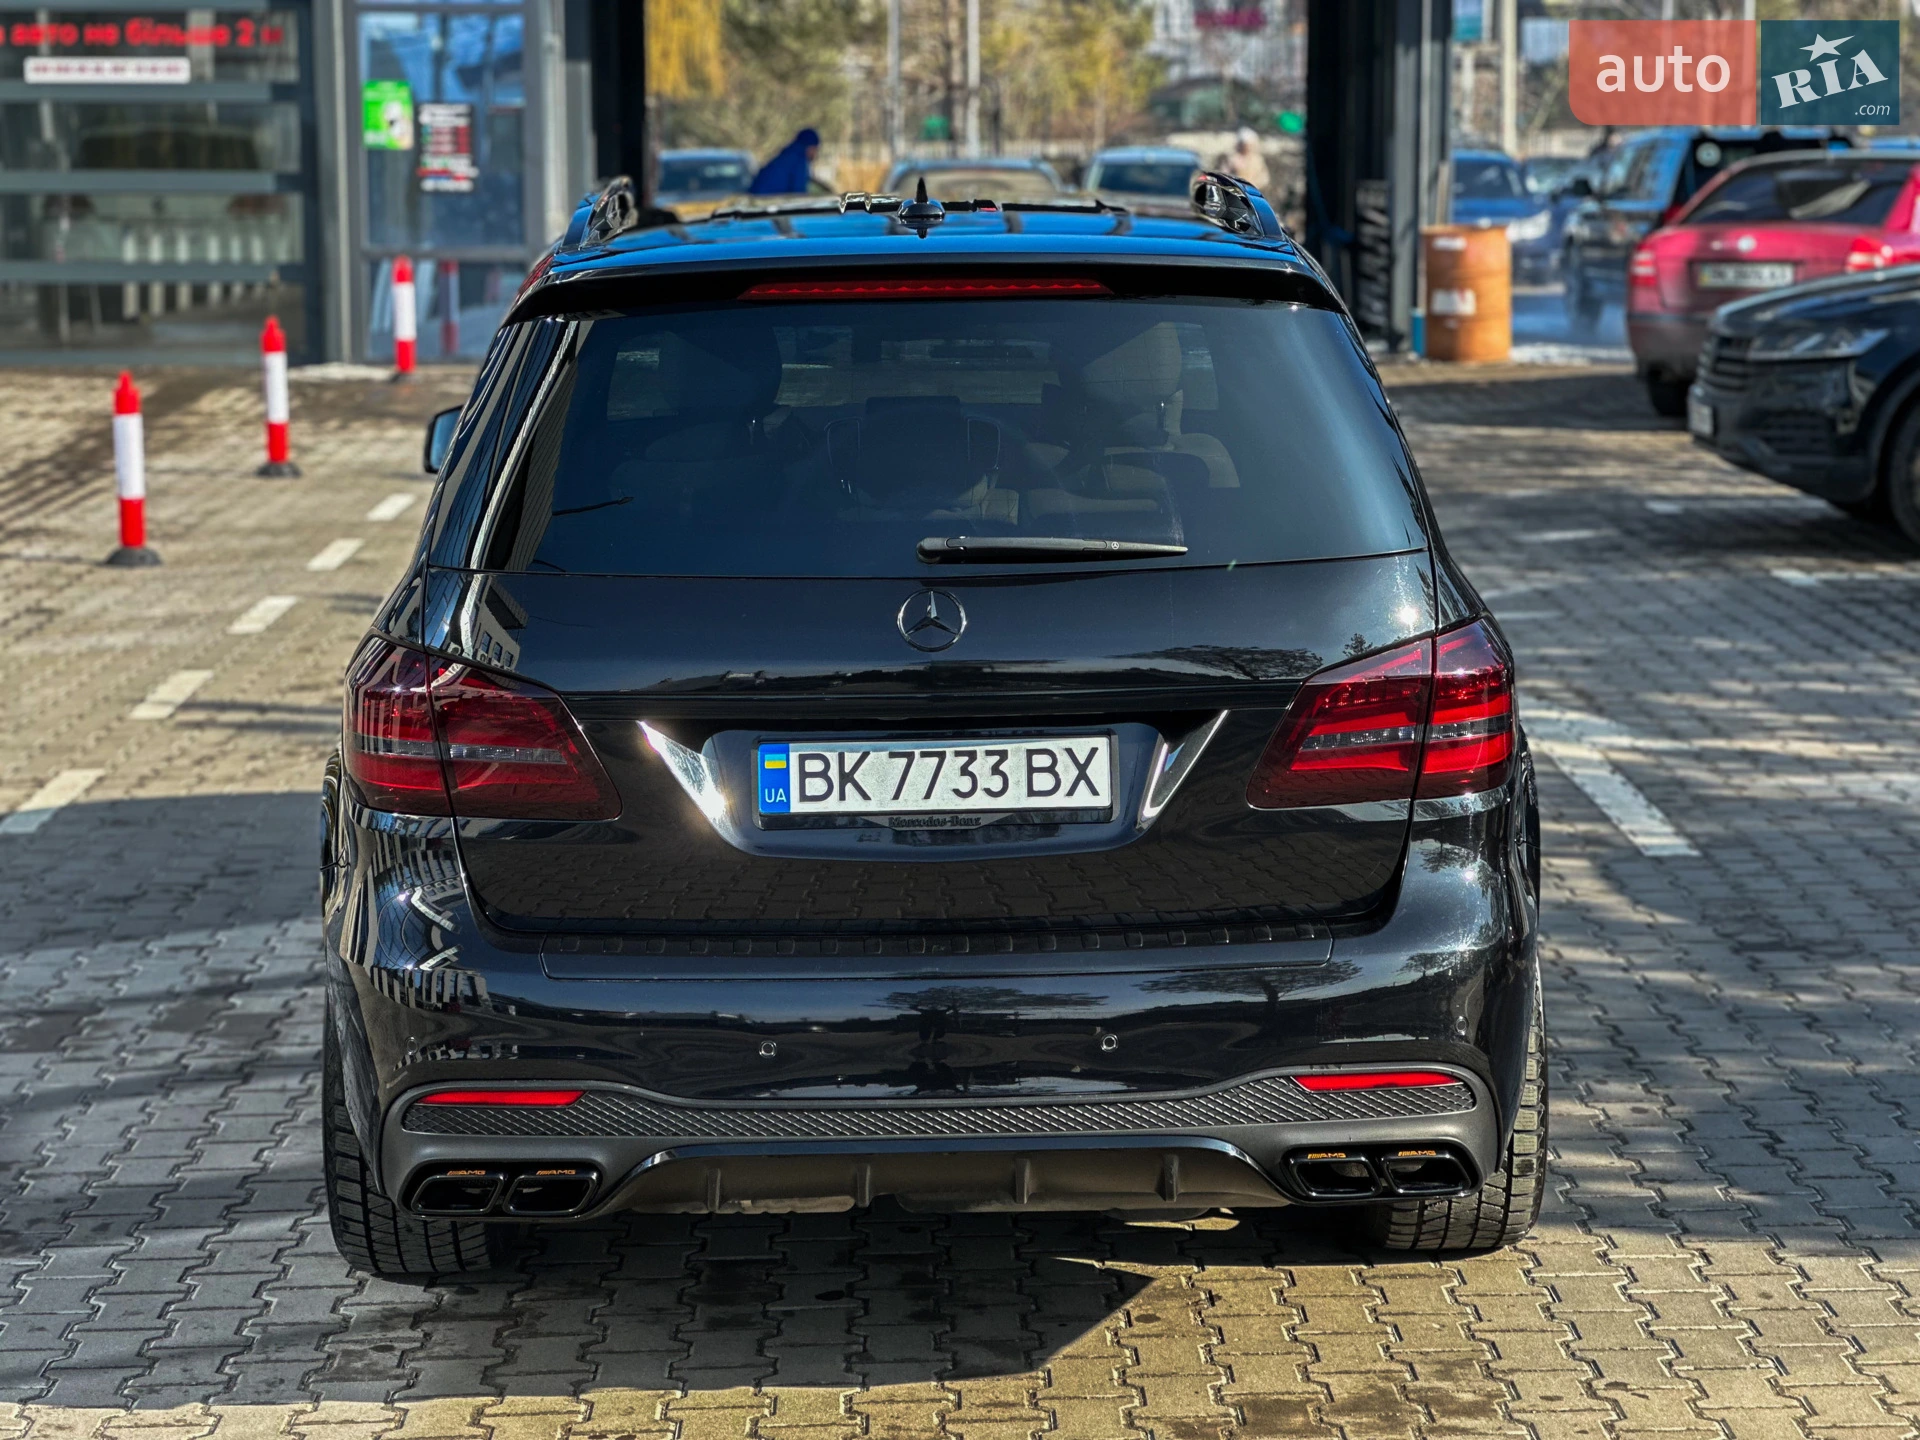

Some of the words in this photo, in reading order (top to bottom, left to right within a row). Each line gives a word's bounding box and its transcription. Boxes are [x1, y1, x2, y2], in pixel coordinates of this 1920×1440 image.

[236, 17, 256, 47] 2
[798, 751, 872, 803] BK
[888, 749, 1010, 801] 7733
[1025, 747, 1101, 798] BX
[764, 788, 788, 804] UA
